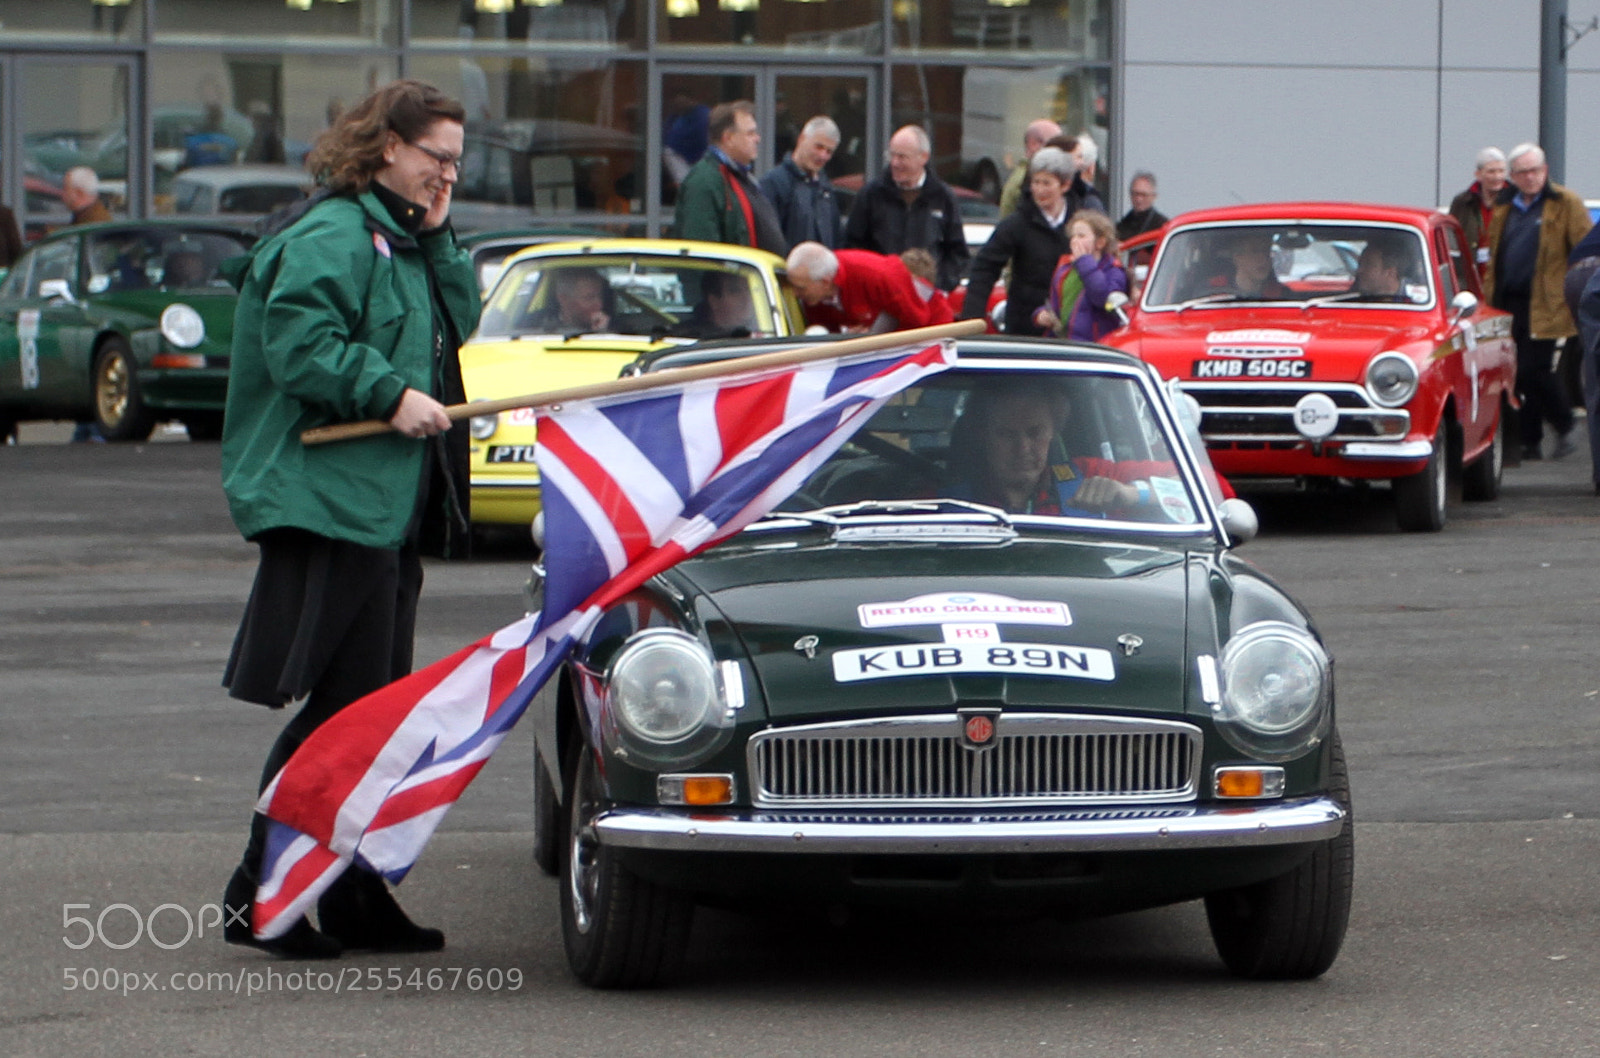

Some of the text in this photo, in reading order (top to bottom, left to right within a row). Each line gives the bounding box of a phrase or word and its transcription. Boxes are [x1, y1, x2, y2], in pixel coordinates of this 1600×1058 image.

[1197, 360, 1306, 377] KMB 505C
[871, 604, 1058, 616] RETRO CHALLENGE
[955, 628, 989, 639] R9
[858, 647, 1090, 673] KUB 89N
[966, 716, 993, 742] MG
